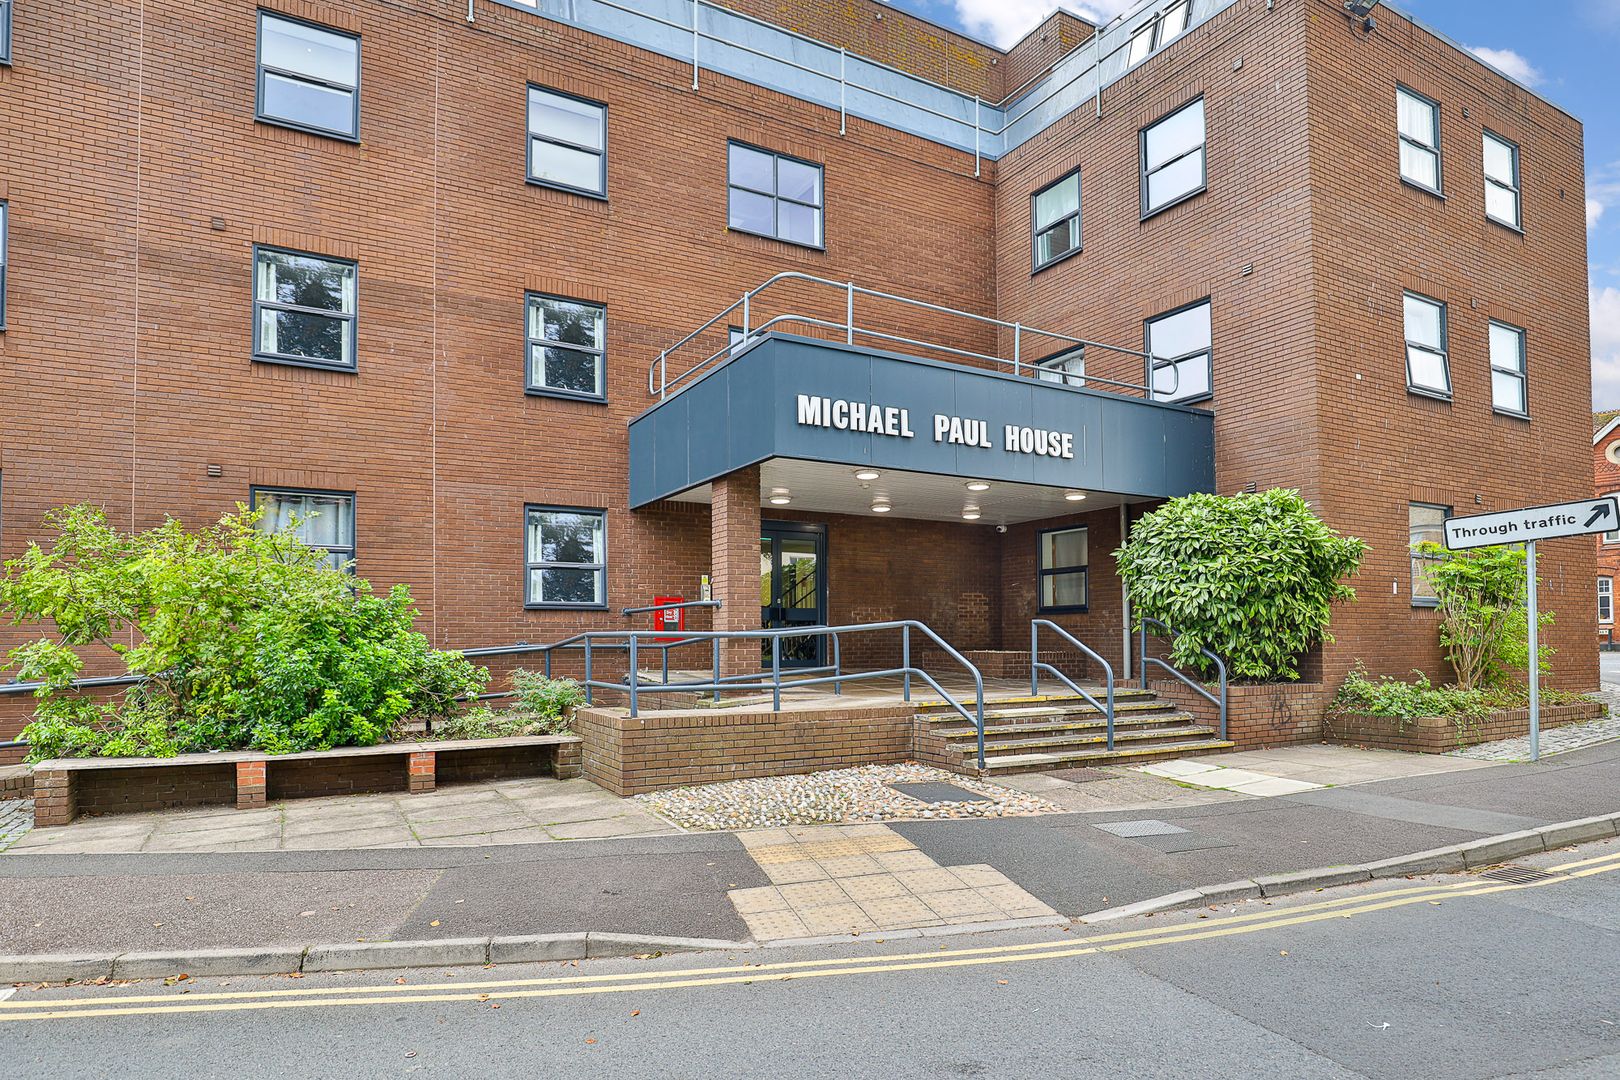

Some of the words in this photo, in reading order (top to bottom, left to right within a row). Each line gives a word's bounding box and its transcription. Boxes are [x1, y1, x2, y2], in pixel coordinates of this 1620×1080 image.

[797, 394, 915, 438] MICHAEL
[933, 414, 992, 448] PAUL
[1004, 424, 1074, 459] HOUSE
[1452, 521, 1518, 539] Through
[1523, 514, 1577, 531] traffic
